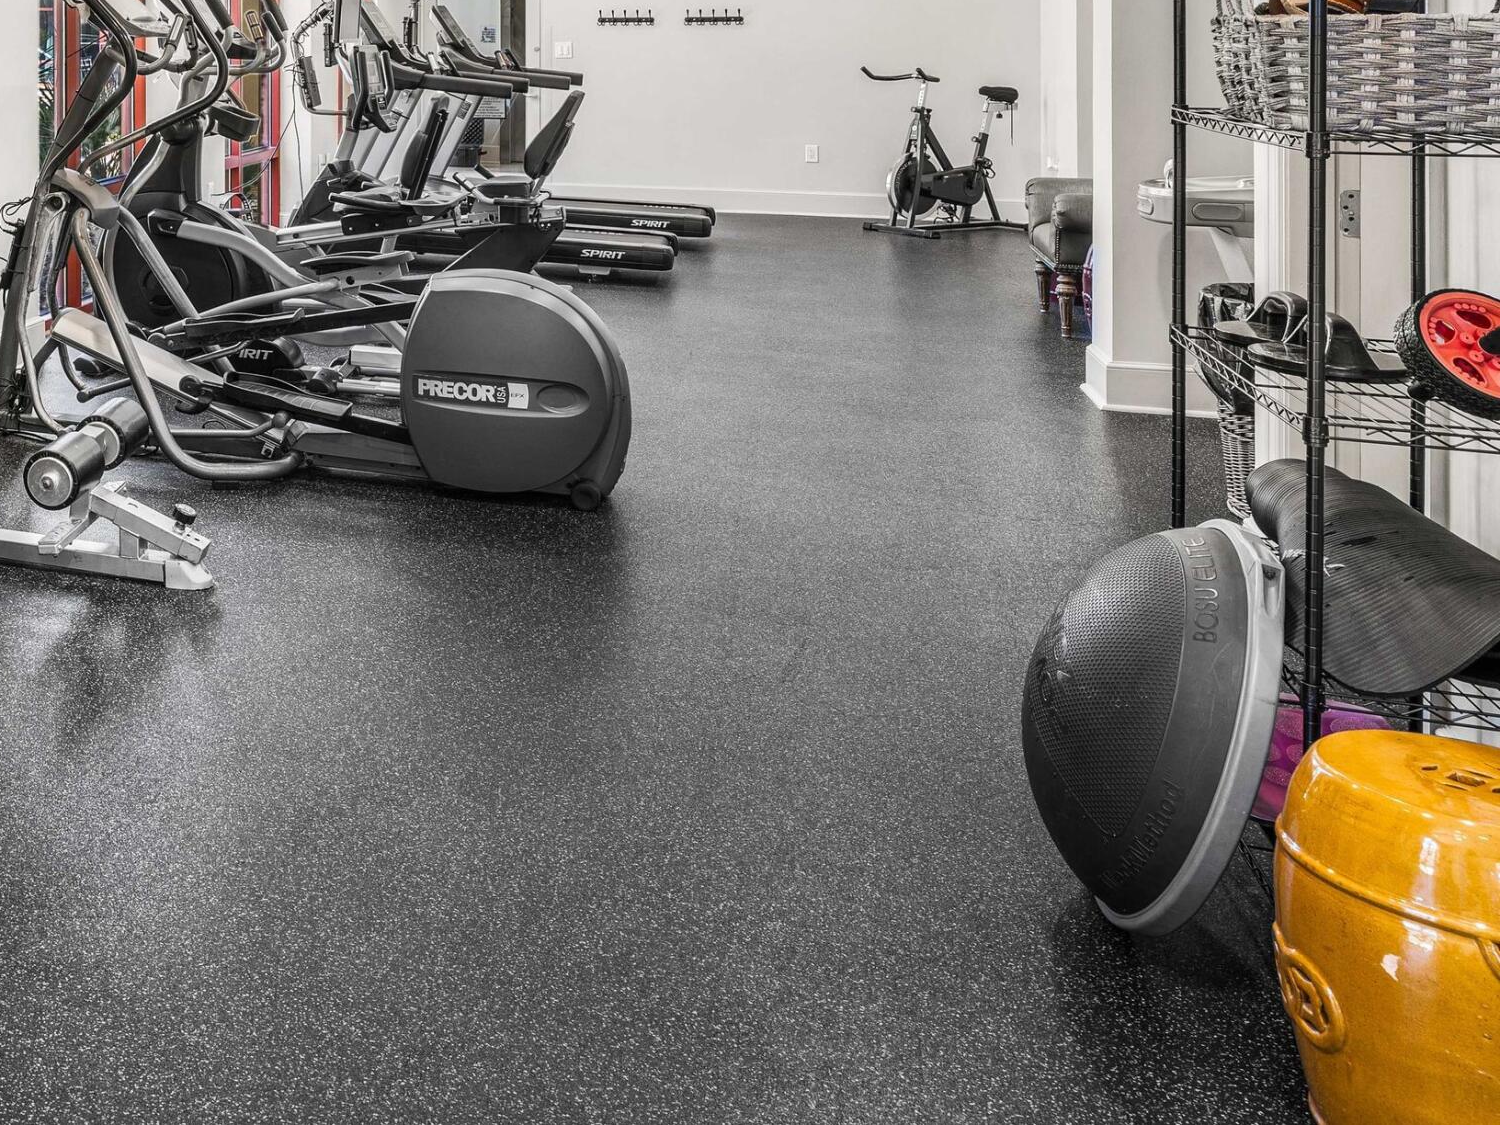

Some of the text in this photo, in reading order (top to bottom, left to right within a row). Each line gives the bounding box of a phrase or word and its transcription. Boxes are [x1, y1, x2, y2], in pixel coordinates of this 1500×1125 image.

[630, 219, 670, 229] SPIRIT
[580, 249, 625, 259] SPIRIT
[238, 348, 273, 360] IRIT
[418, 378, 496, 402] PRECOR
[497, 386, 506, 403] USA
[1181, 536, 1219, 644] BOSU ELITE
